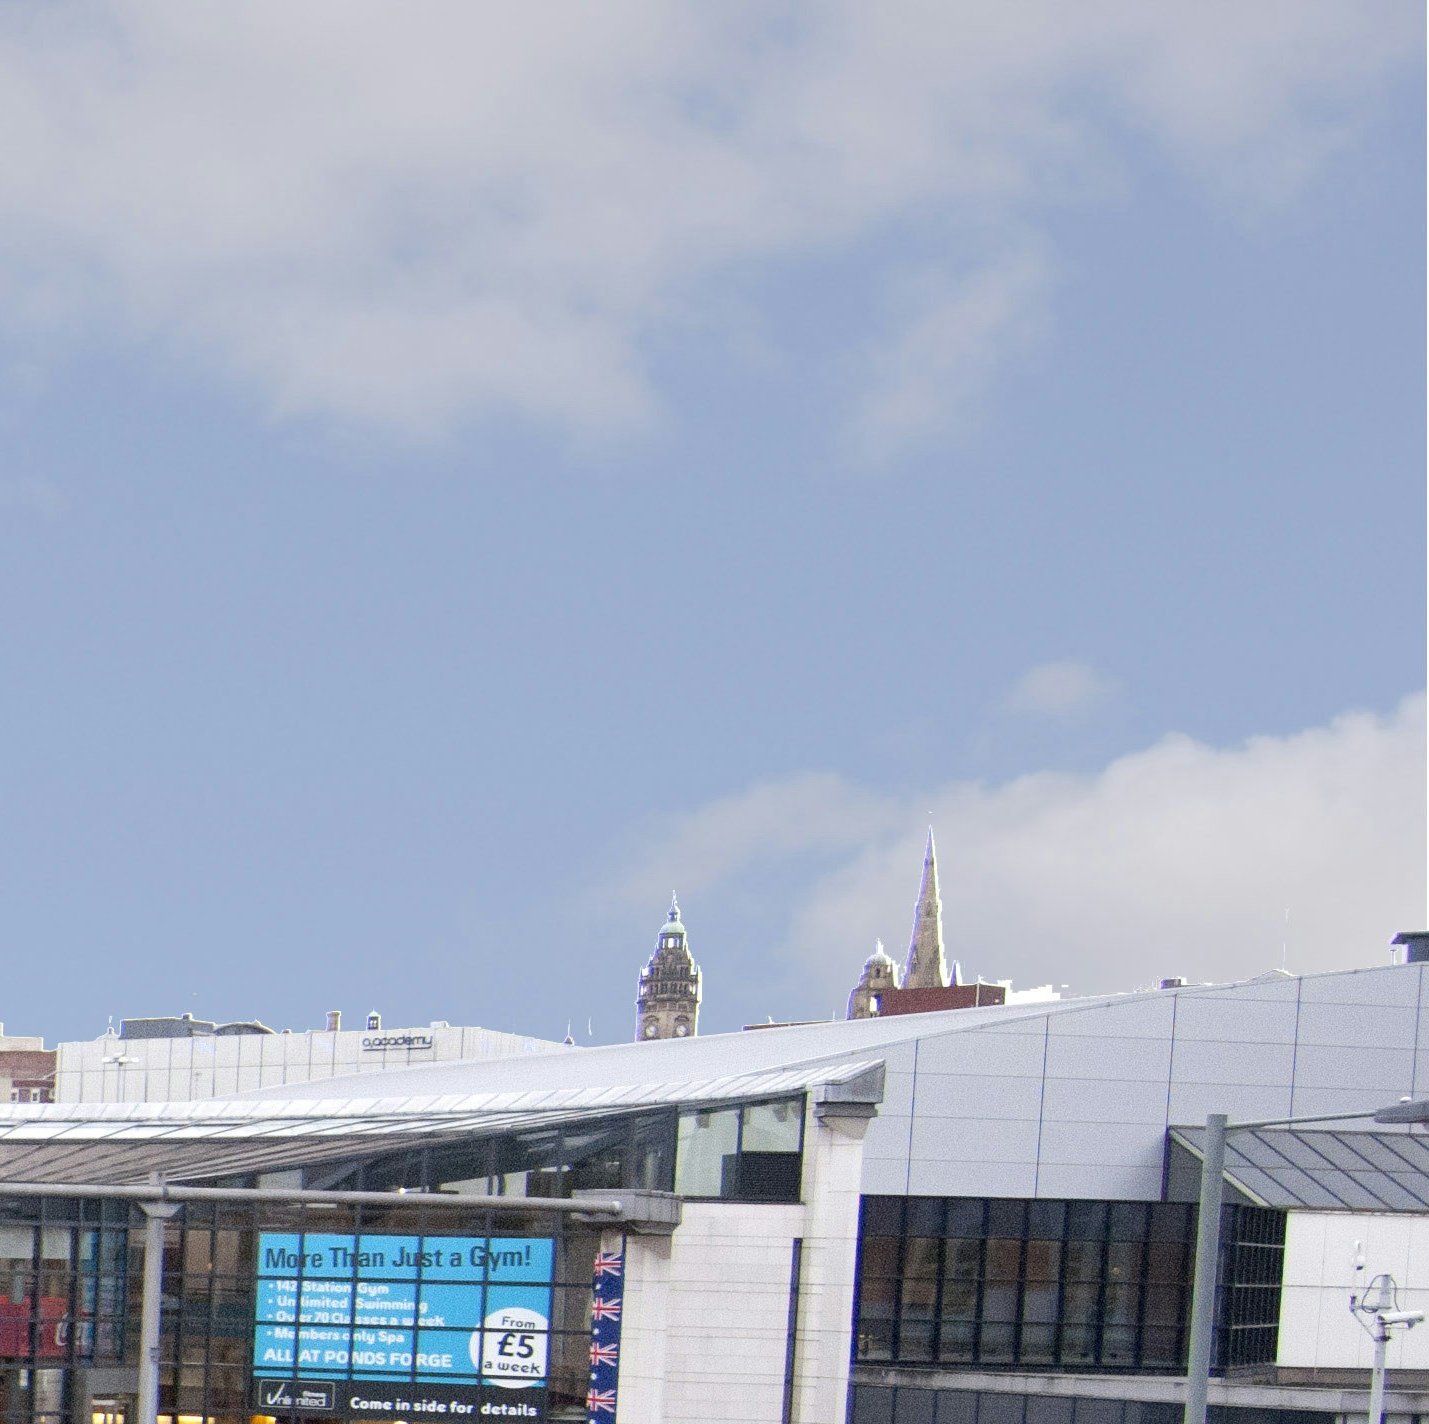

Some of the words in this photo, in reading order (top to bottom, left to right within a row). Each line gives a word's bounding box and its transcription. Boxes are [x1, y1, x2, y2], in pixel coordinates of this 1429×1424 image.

[265, 1248, 323, 1269] More
[328, 1247, 385, 1268] Than
[393, 1246, 444, 1268] Just
[449, 1252, 462, 1267] a
[470, 1245, 531, 1272] Gym!
[276, 1280, 298, 1292] 142
[303, 1280, 352, 1293] Station
[357, 1282, 389, 1297] Gym
[277, 1296, 349, 1309] Unlimited
[355, 1298, 428, 1313] Swimming
[276, 1311, 312, 1322] Over
[331, 1312, 388, 1325] Classes
[402, 1316, 445, 1327] week
[501, 1316, 536, 1329] From
[274, 1327, 340, 1341] Members
[342, 1329, 376, 1345] only
[378, 1331, 405, 1344] Spa
[497, 1333, 535, 1359] £5
[264, 1348, 294, 1362] ALL
[299, 1349, 321, 1363] AT
[325, 1351, 387, 1366] PONDS
[390, 1352, 453, 1368] FORGE
[484, 1362, 493, 1370] a
[498, 1362, 542, 1375] week
[350, 1397, 392, 1411] Come
[450, 1401, 474, 1414] for
[480, 1403, 538, 1417] details
